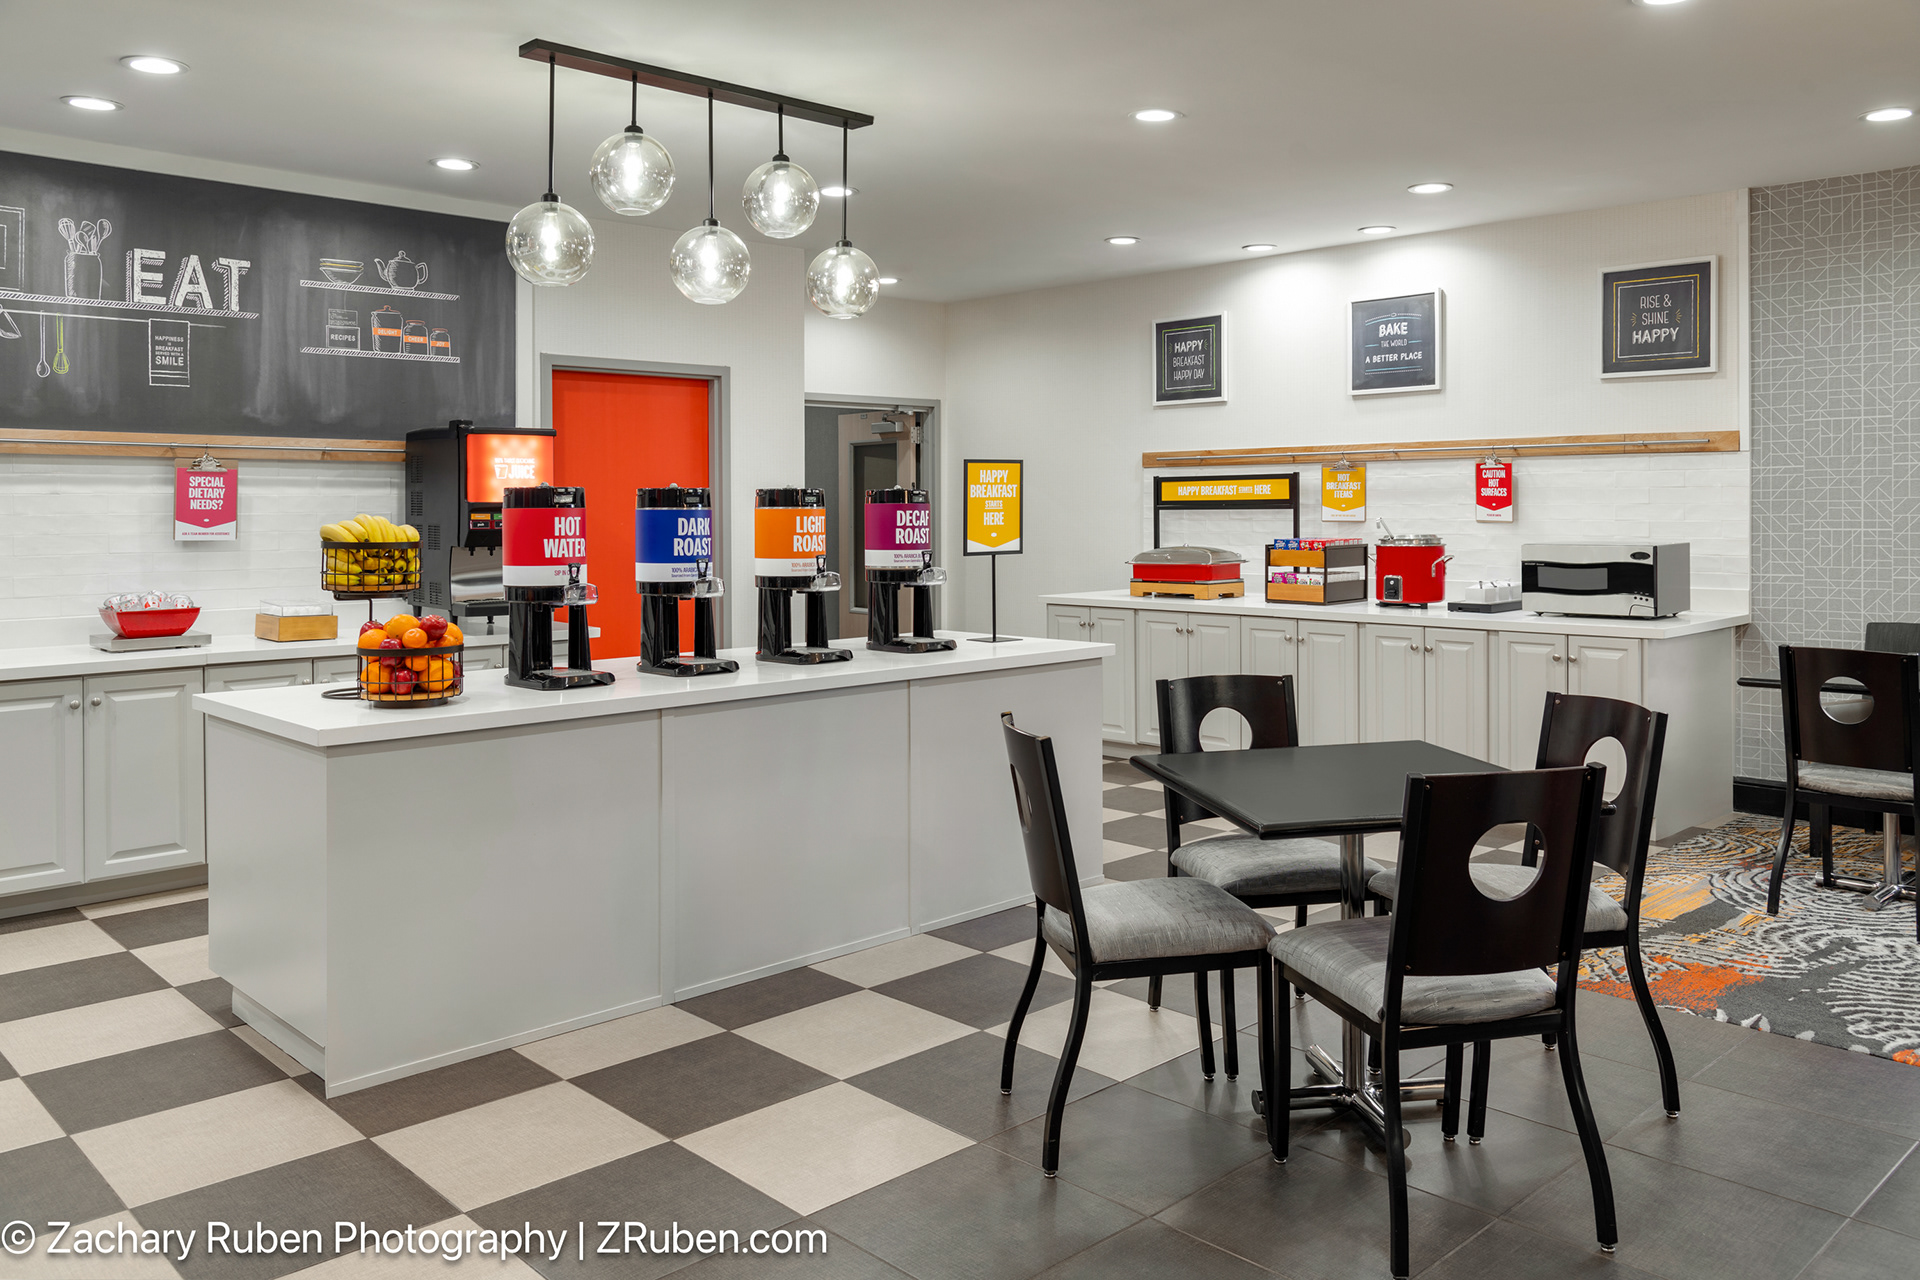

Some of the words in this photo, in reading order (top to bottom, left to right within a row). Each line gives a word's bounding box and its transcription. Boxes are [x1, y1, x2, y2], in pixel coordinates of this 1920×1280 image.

[126, 248, 251, 312] EAT
[1640, 295, 1660, 309] RISE
[1663, 293, 1672, 307] &
[1641, 311, 1669, 326] SHINE
[1378, 322, 1408, 338] BAKE
[1632, 327, 1679, 344] HAPPY
[330, 333, 356, 342] RECIPES
[1390, 339, 1407, 347] WORLD
[1174, 339, 1204, 353] HAPPY
[155, 355, 184, 366] SMILE
[1172, 354, 1205, 367] BREAKFAST
[1372, 353, 1398, 363] BETTER
[1400, 351, 1422, 361] PLACE
[1173, 369, 1192, 381] HAPPY
[1193, 368, 1205, 379] DAY
[508, 464, 535, 479] JUICE
[980, 469, 1009, 483] HAPPY
[1337, 473, 1350, 481] HOT
[1482, 469, 1506, 478] CAUTION
[189, 476, 225, 487] SPECIAL
[1326, 482, 1361, 490] BREAKFAST
[1488, 479, 1499, 487] HOT
[188, 487, 226, 499] DIETARY
[970, 484, 1017, 498] BREAKFAST
[1178, 486, 1199, 496] HAPPY
[1200, 485, 1238, 496] BREAKFAST
[1254, 484, 1271, 495] HERE
[1334, 490, 1353, 498] ITEMS
[1480, 488, 1507, 497] SURFACES
[190, 499, 224, 510] NEEDS?
[984, 500, 1003, 508] STARTS
[796, 516, 825, 533] LIGHT
[896, 510, 929, 527] DECAF
[983, 512, 1004, 526] HERE
[554, 516, 581, 536] HOT
[677, 517, 710, 536] DARK
[895, 528, 929, 544] ROAST
[543, 538, 586, 558] WATER
[673, 537, 712, 557] ROAST
[793, 535, 825, 552] ROAST
